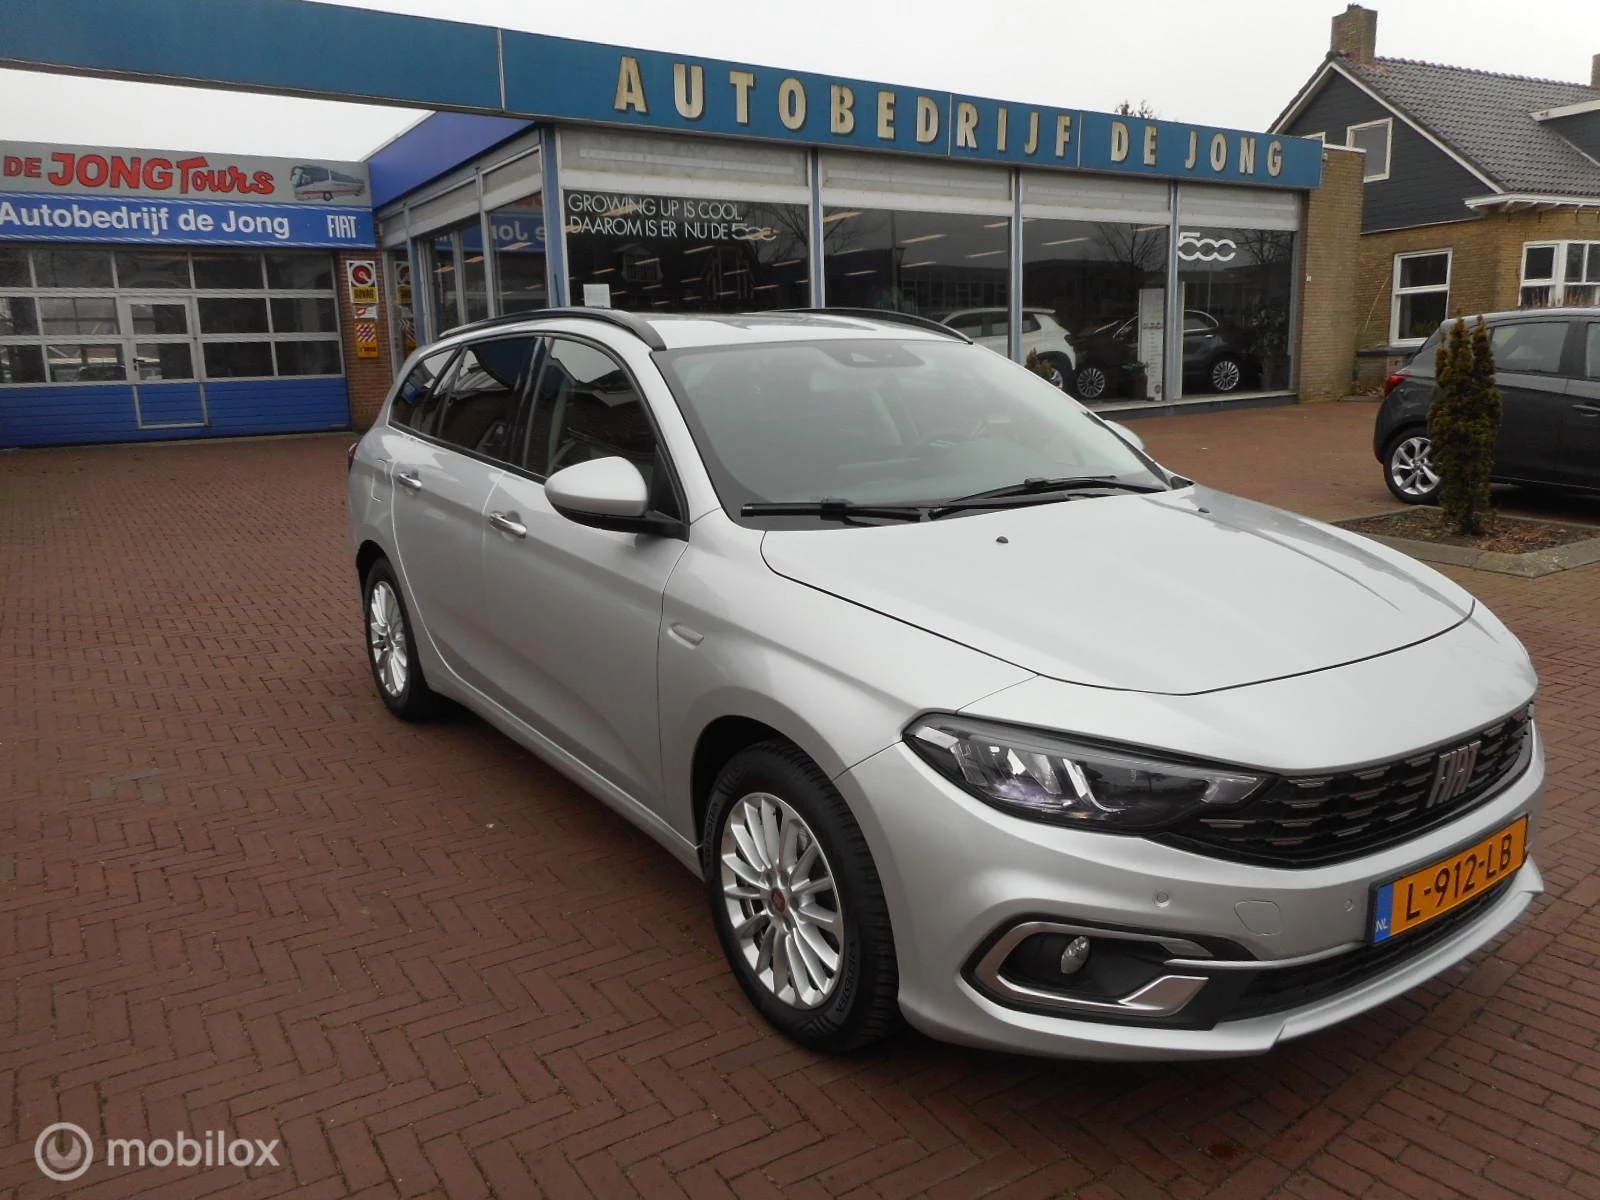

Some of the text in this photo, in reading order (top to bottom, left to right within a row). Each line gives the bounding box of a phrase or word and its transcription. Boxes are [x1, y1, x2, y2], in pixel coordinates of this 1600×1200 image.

[613, 55, 1284, 177] AUTOBEDRIJF DE JONG
[3, 152, 276, 195] DE JONG Tours
[0, 201, 290, 239] Autobedrijf de Jong
[568, 193, 657, 216] GROWING
[660, 199, 679, 216] UP
[683, 200, 696, 218] IS
[326, 214, 357, 239] FIAT
[569, 215, 777, 240] DAAROM IS ER NU DE 500
[1177, 231, 1236, 261] 500
[1426, 740, 1481, 808] FIAT
[1405, 833, 1513, 921] L-912-LB
[1376, 919, 1388, 932] NL
